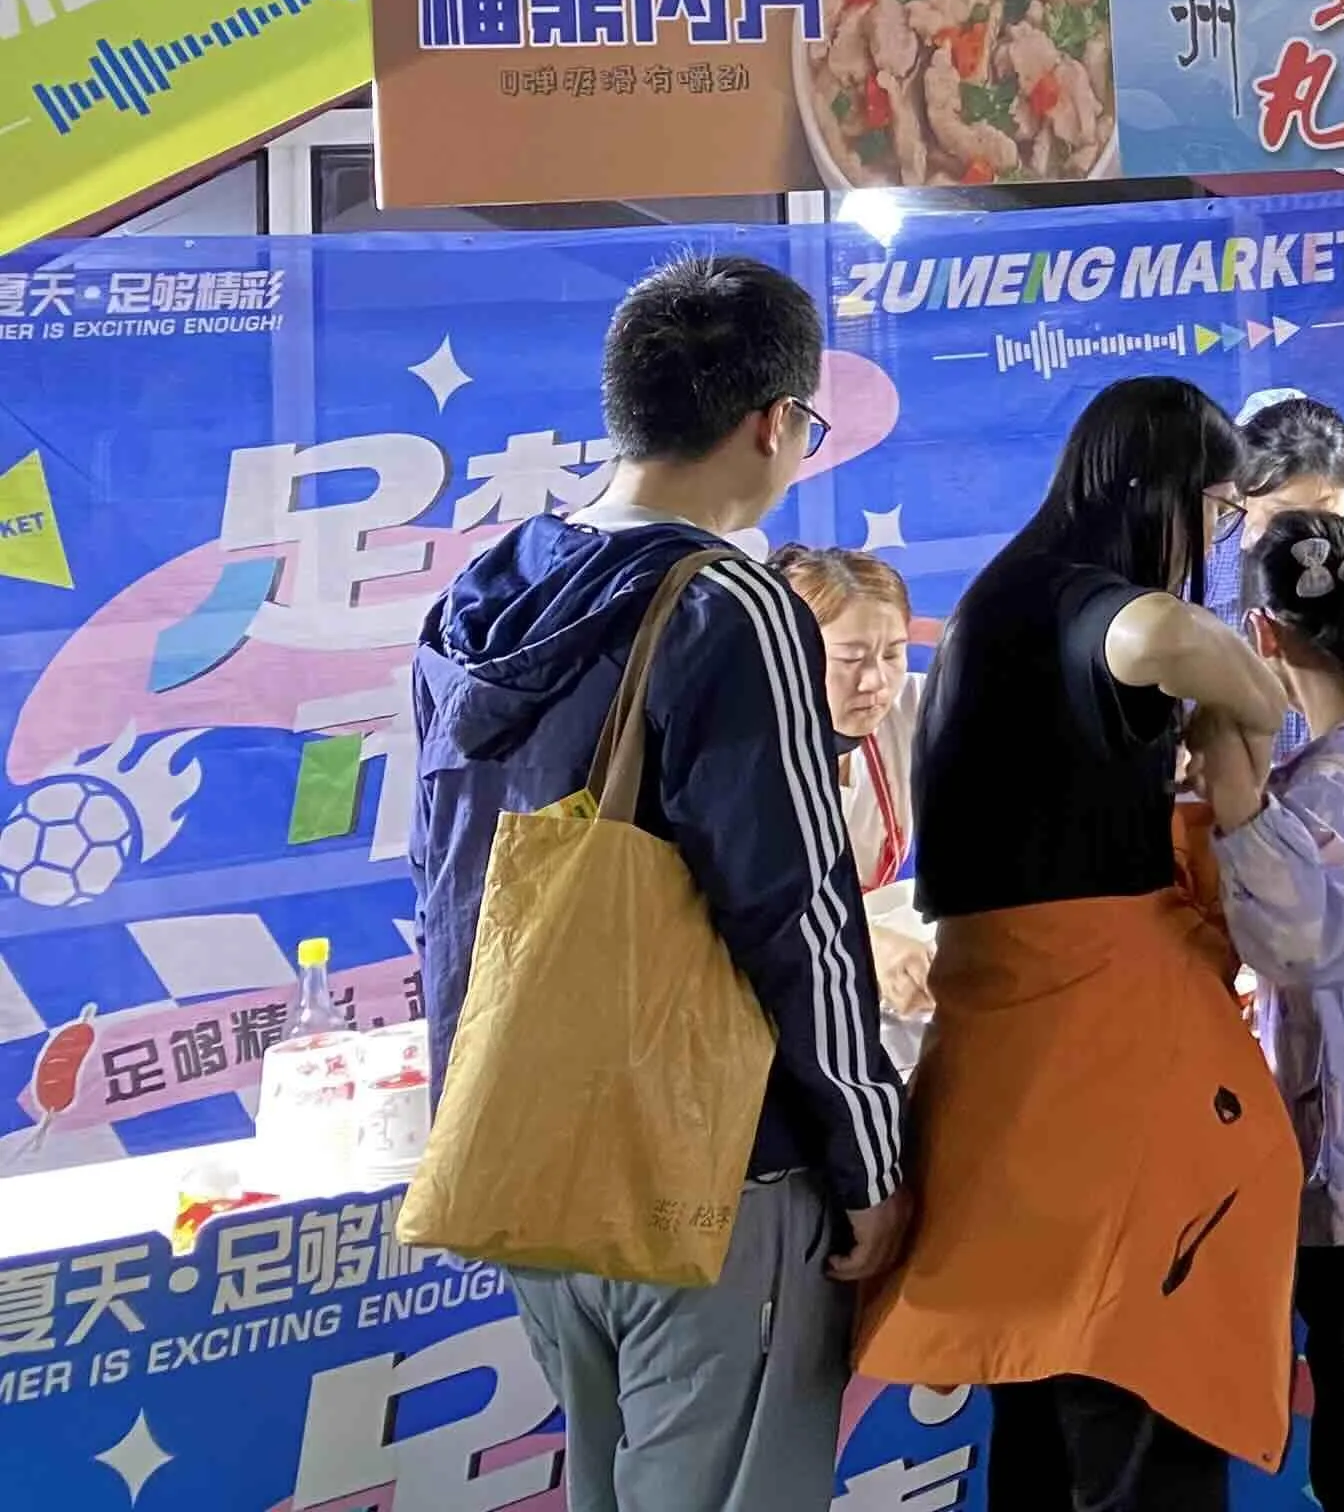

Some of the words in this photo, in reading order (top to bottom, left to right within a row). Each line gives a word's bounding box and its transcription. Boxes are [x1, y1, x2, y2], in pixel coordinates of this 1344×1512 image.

[837, 246, 1115, 318] ZUMENG
[0, 323, 33, 340] ER
[43, 322, 65, 339] IS
[73, 318, 176, 338] EXCITING
[183, 314, 284, 335] ENOUGH!
[89, 1349, 131, 1387] IS
[147, 1303, 342, 1375] EXCITING
